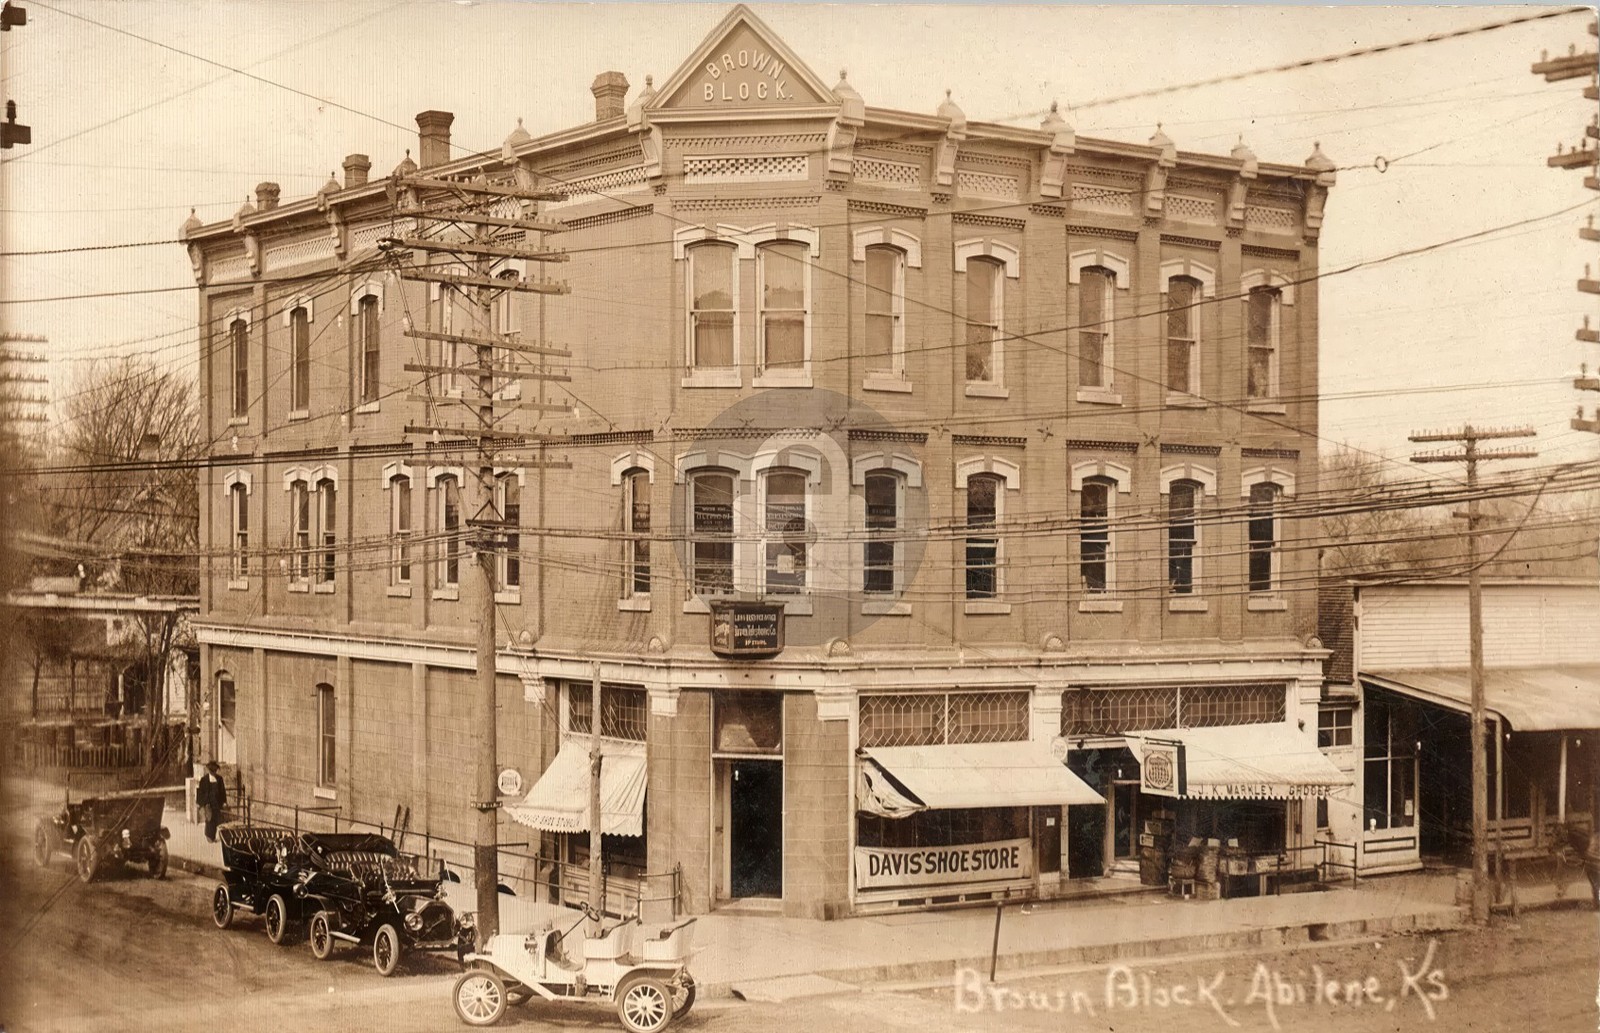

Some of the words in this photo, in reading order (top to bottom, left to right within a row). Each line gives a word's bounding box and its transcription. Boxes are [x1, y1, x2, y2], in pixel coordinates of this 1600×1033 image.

[705, 50, 785, 80] BROWN
[704, 80, 793, 101] BLOCK.
[869, 851, 926, 876] DAVIS'
[925, 850, 970, 874] SHOE
[971, 846, 1020, 872] STORE
